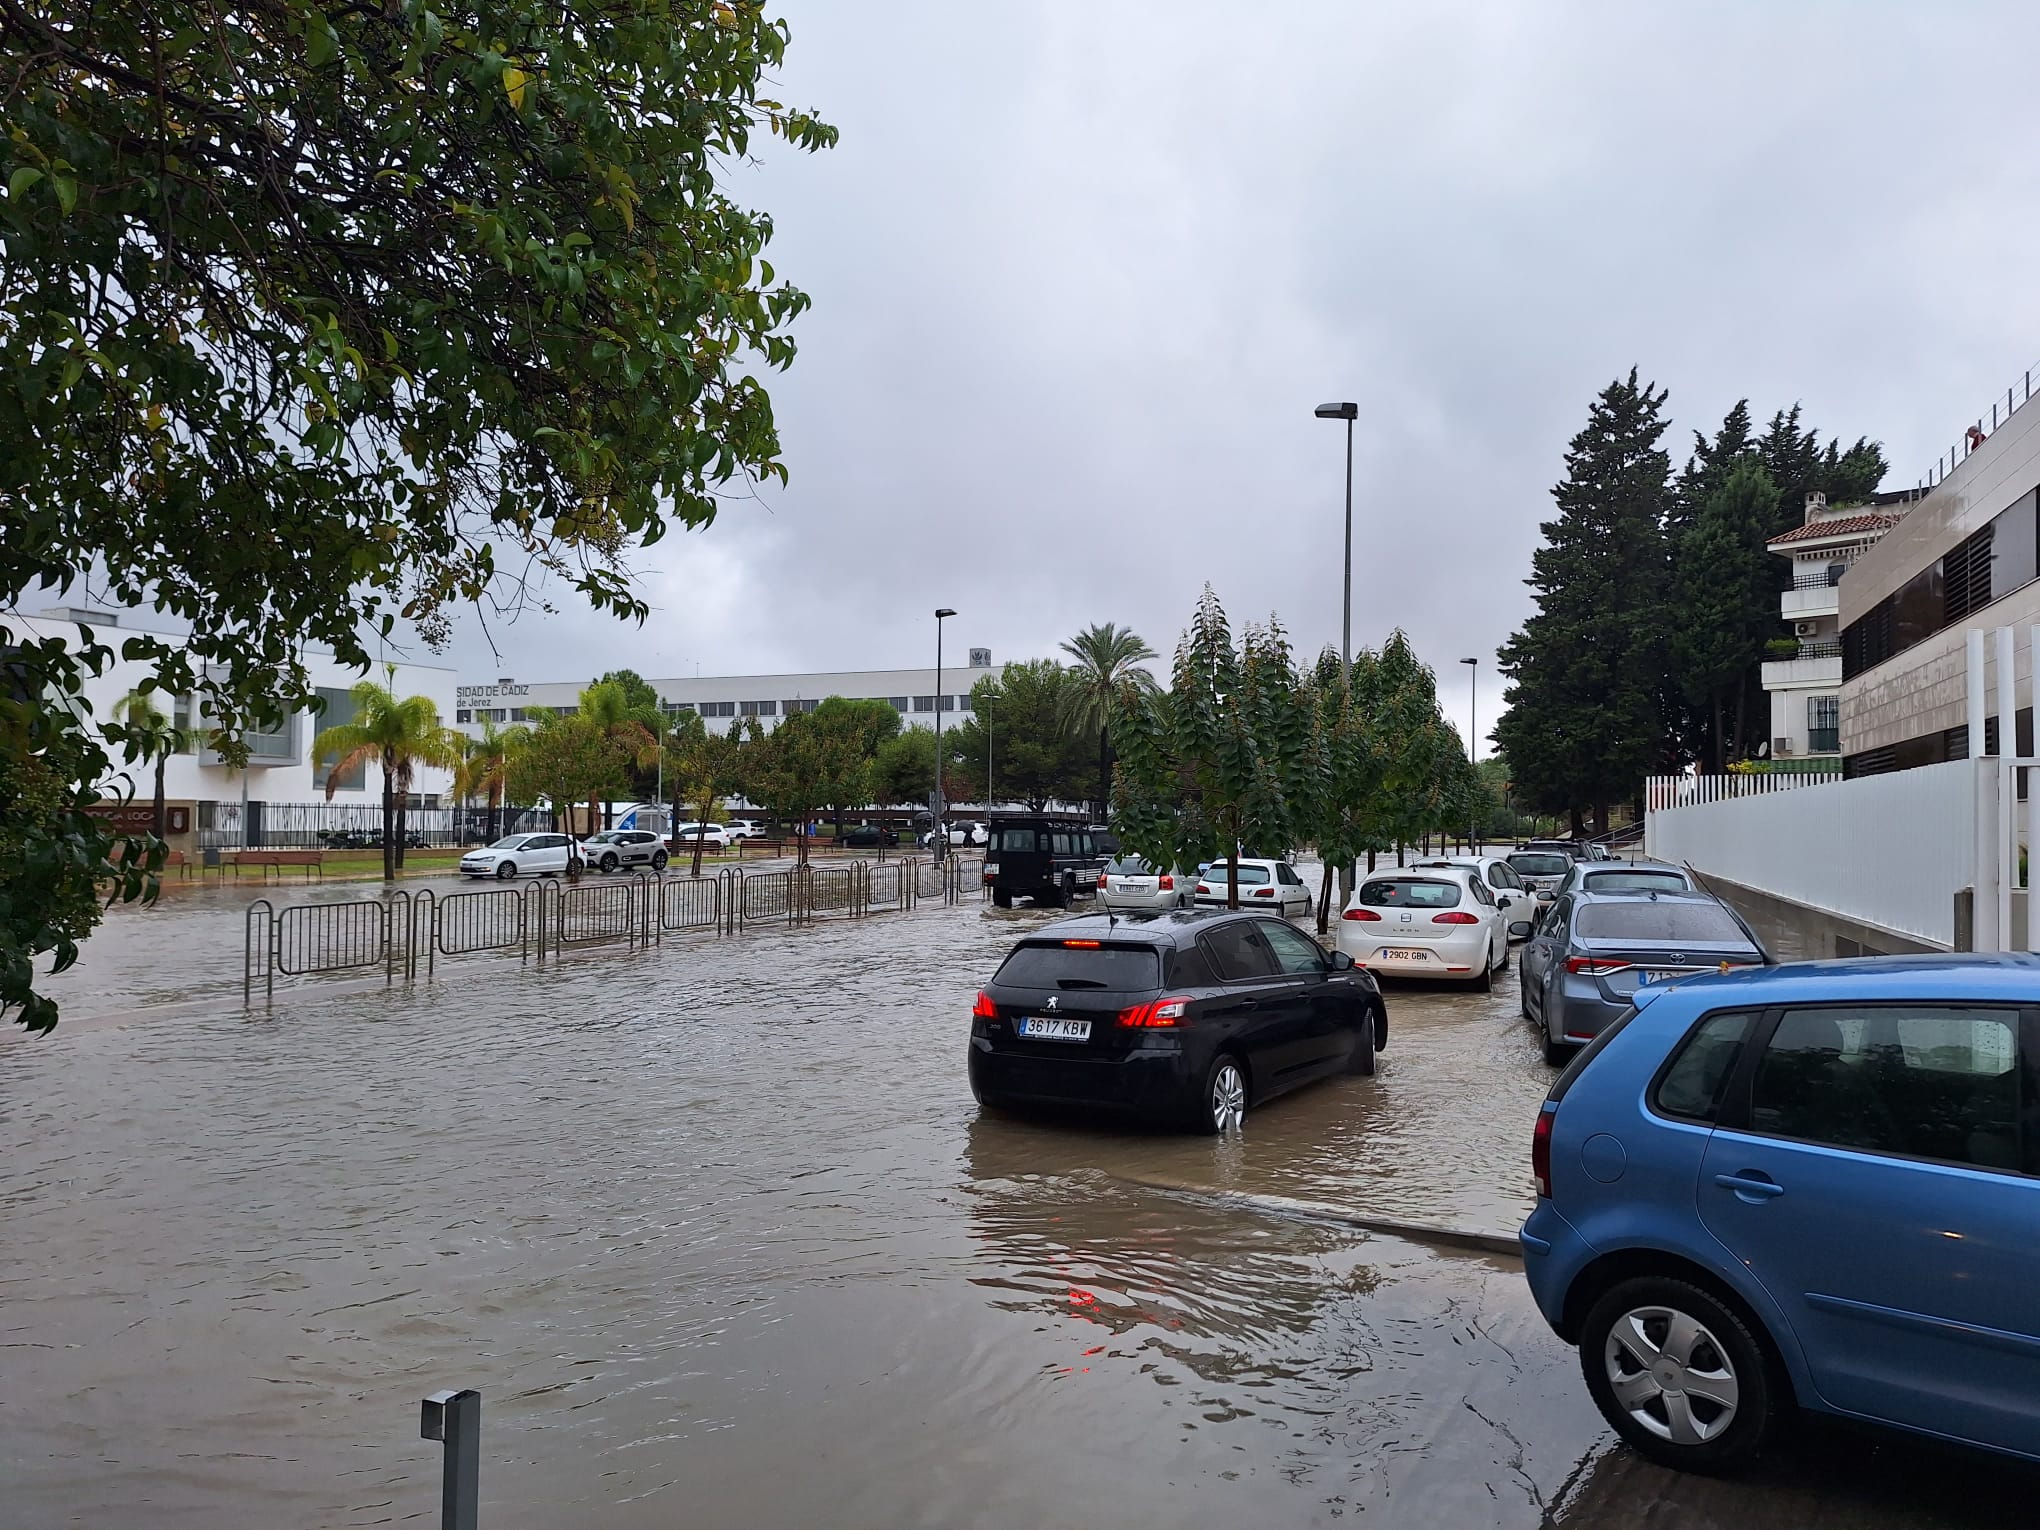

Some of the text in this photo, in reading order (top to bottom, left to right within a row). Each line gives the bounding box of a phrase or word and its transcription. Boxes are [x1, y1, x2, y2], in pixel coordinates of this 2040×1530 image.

[486, 686, 499, 697] DE
[456, 697, 492, 708] de Jerez
[1389, 950, 1428, 961] 2902 GBN
[1028, 1019, 1088, 1036] 3617 KBW
